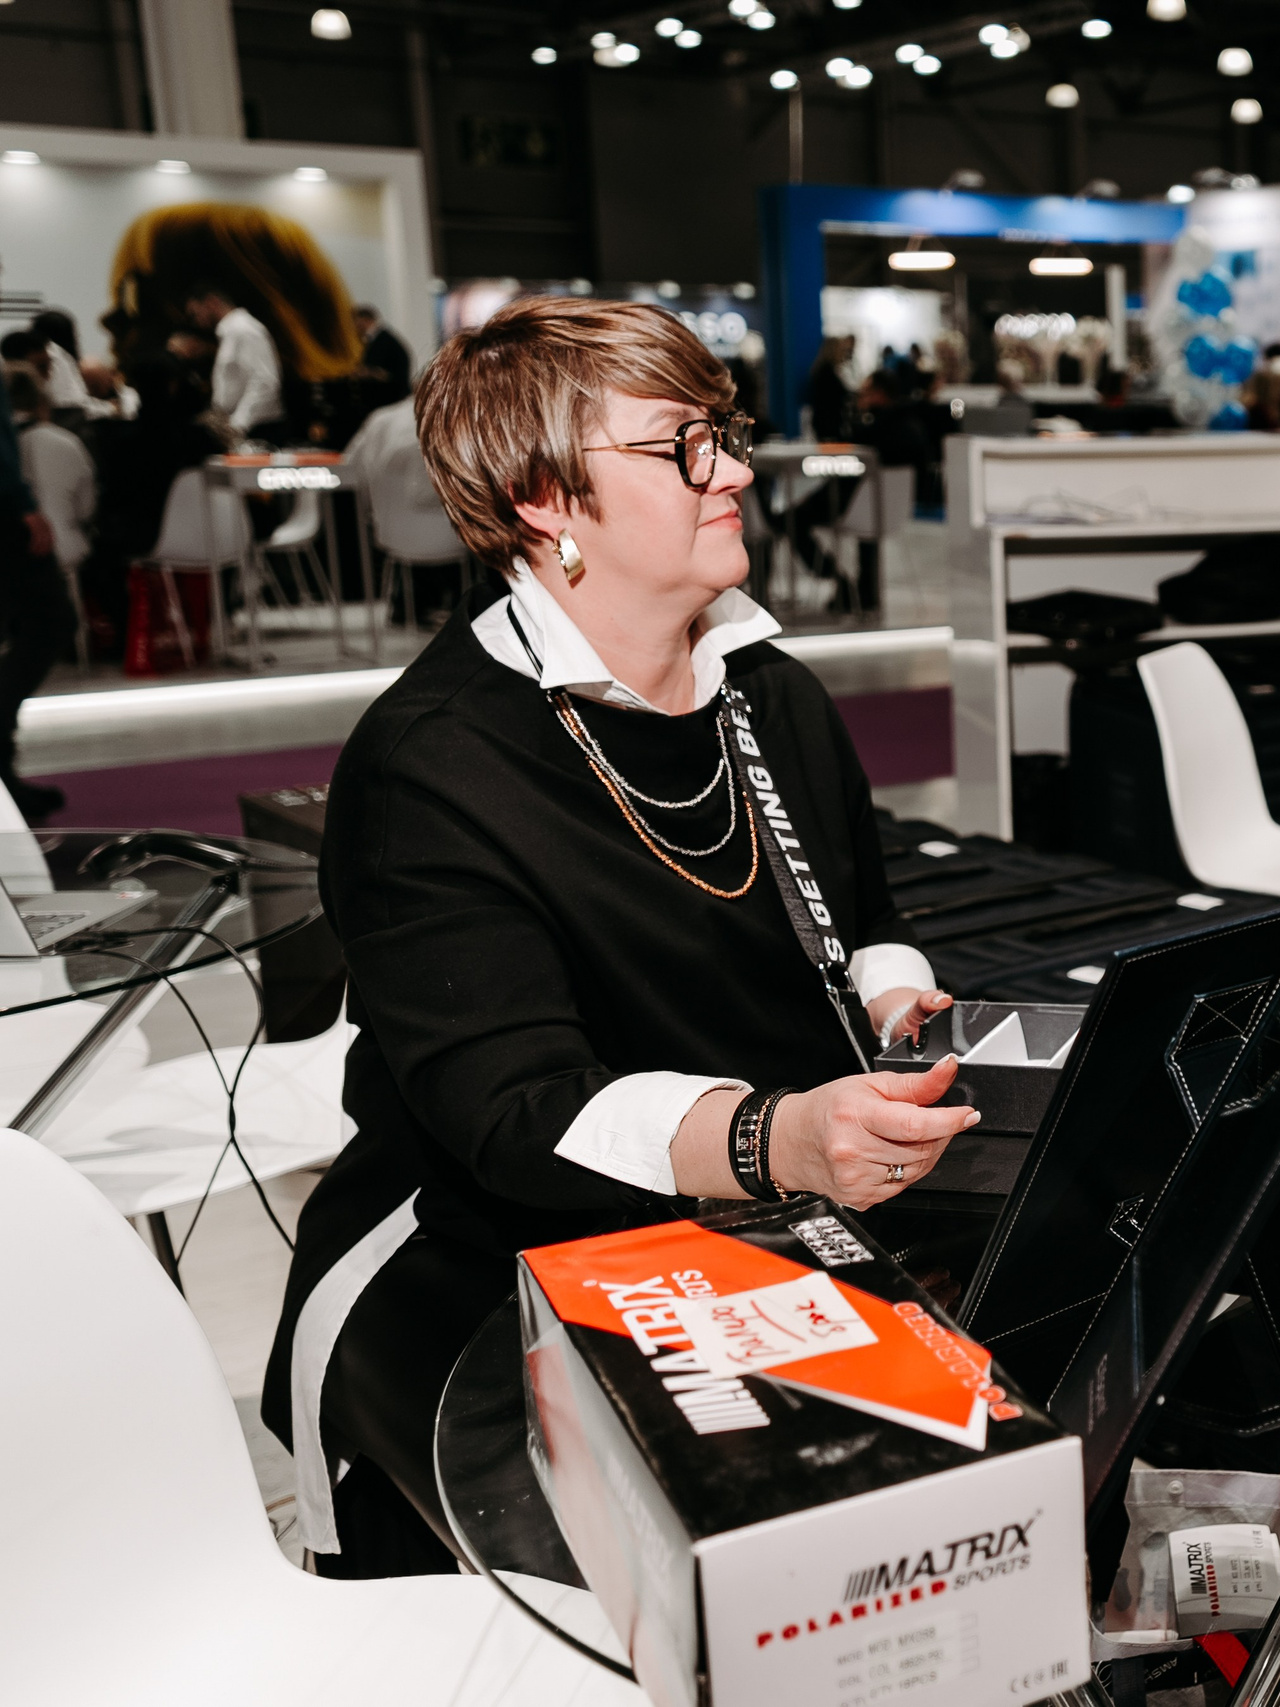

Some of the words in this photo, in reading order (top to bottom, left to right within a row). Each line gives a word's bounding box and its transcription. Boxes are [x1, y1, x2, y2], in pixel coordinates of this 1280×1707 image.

[746, 764, 833, 927] GETTING
[893, 1301, 1024, 1422] POLARIZED
[755, 1578, 948, 1649] POLARIZED
[952, 1552, 1032, 1592] SPORTS
[1205, 1564, 1221, 1617] POLARIZED
